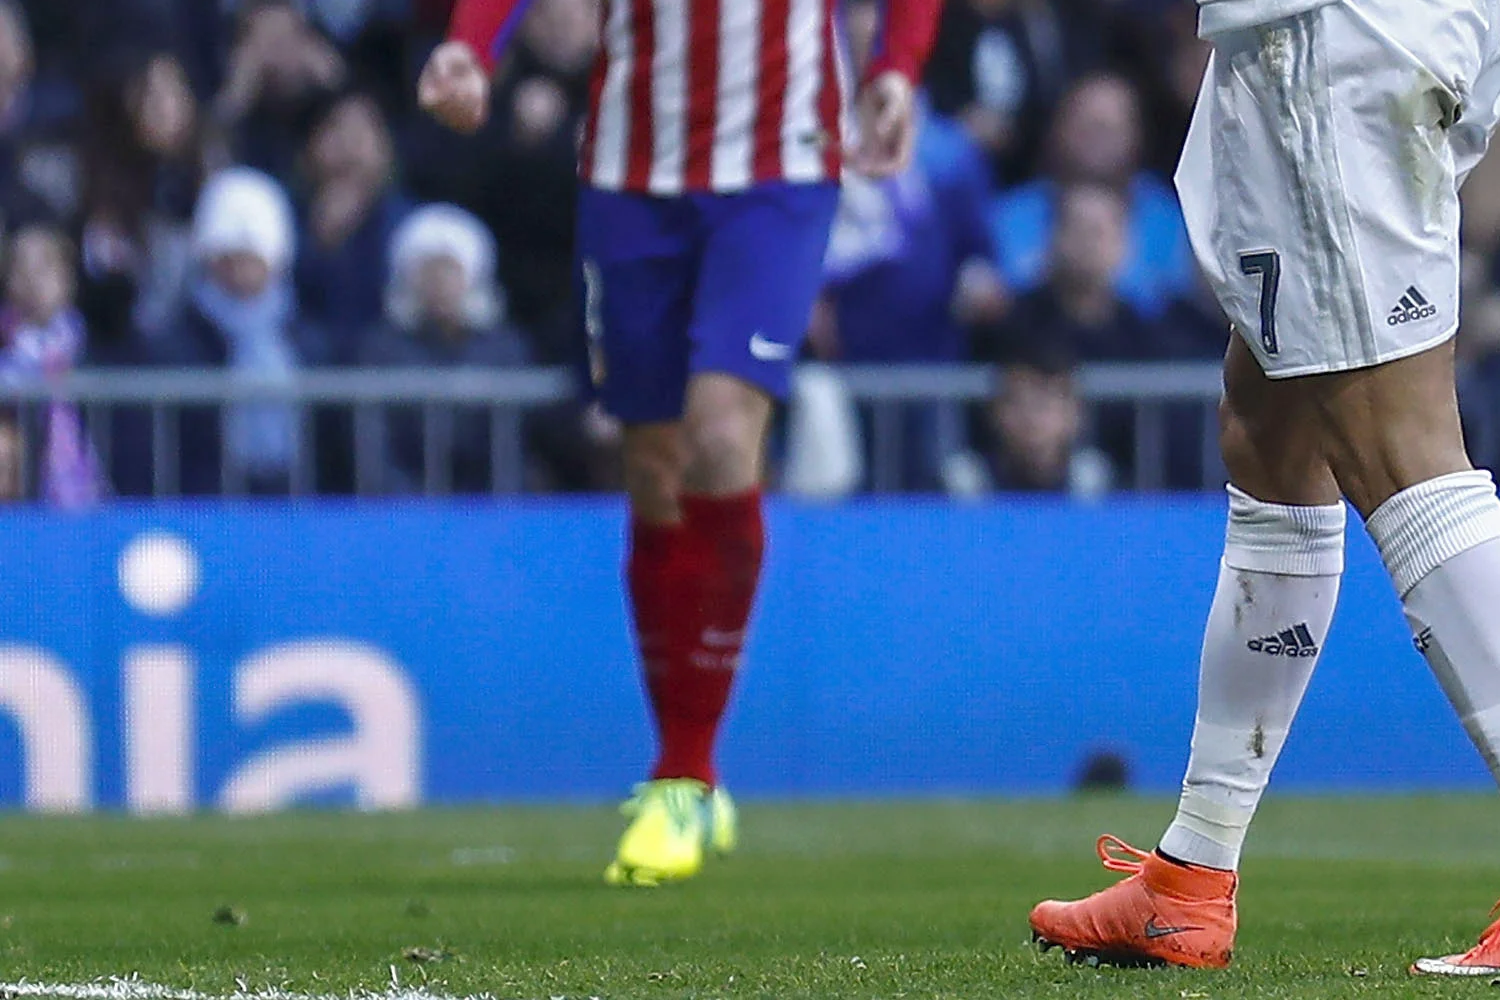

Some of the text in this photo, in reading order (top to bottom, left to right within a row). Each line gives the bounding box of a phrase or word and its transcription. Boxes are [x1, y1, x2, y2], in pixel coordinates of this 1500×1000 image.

[1237, 248, 1281, 356] 7
[1387, 304, 1437, 327] adidas
[1247, 639, 1319, 658] adidas
